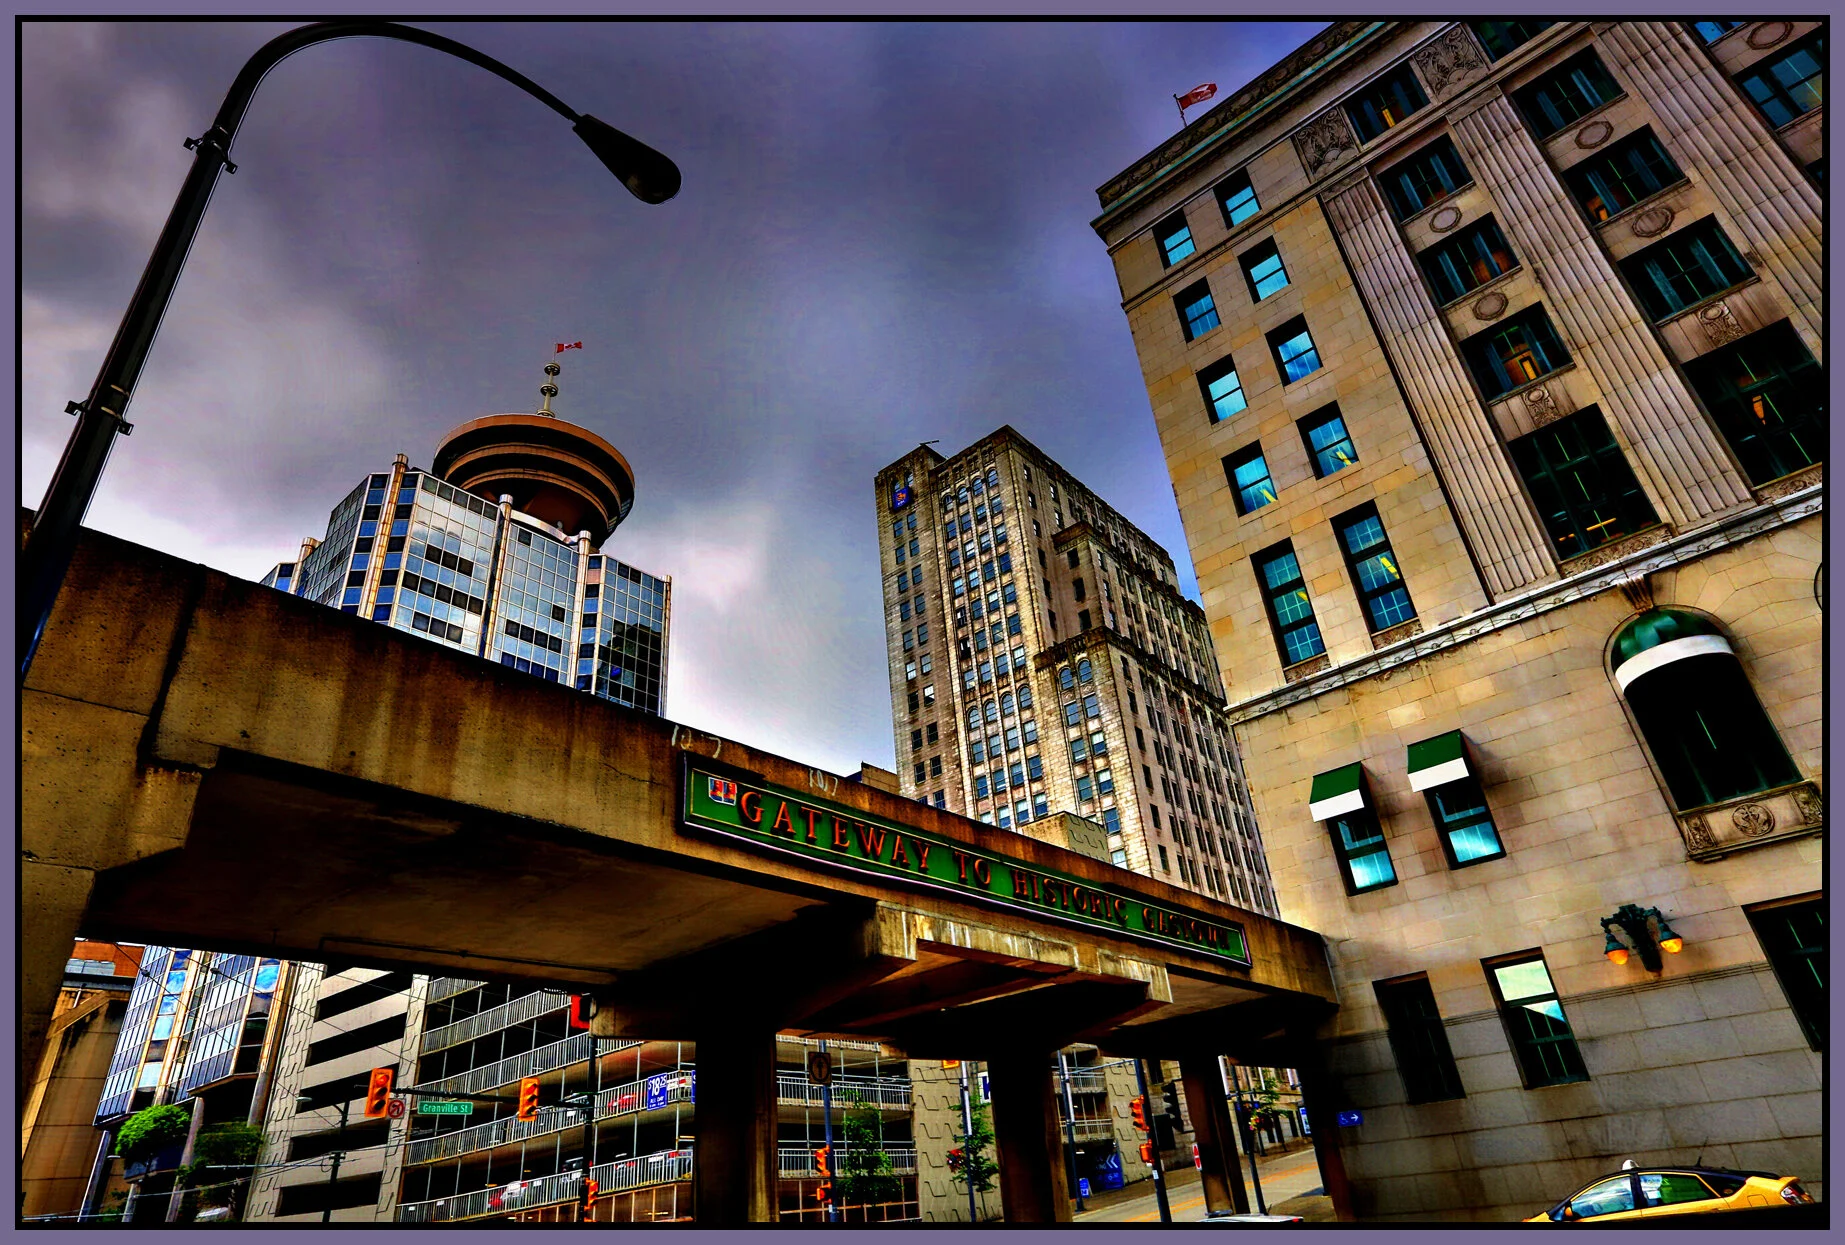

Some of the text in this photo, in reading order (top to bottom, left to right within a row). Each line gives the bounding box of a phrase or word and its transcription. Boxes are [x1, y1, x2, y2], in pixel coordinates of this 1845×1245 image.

[740, 791, 932, 869] GATEWAY
[954, 851, 991, 885] TO
[1012, 868, 1129, 922] HISTORIC
[422, 1103, 468, 1113] Granville St
